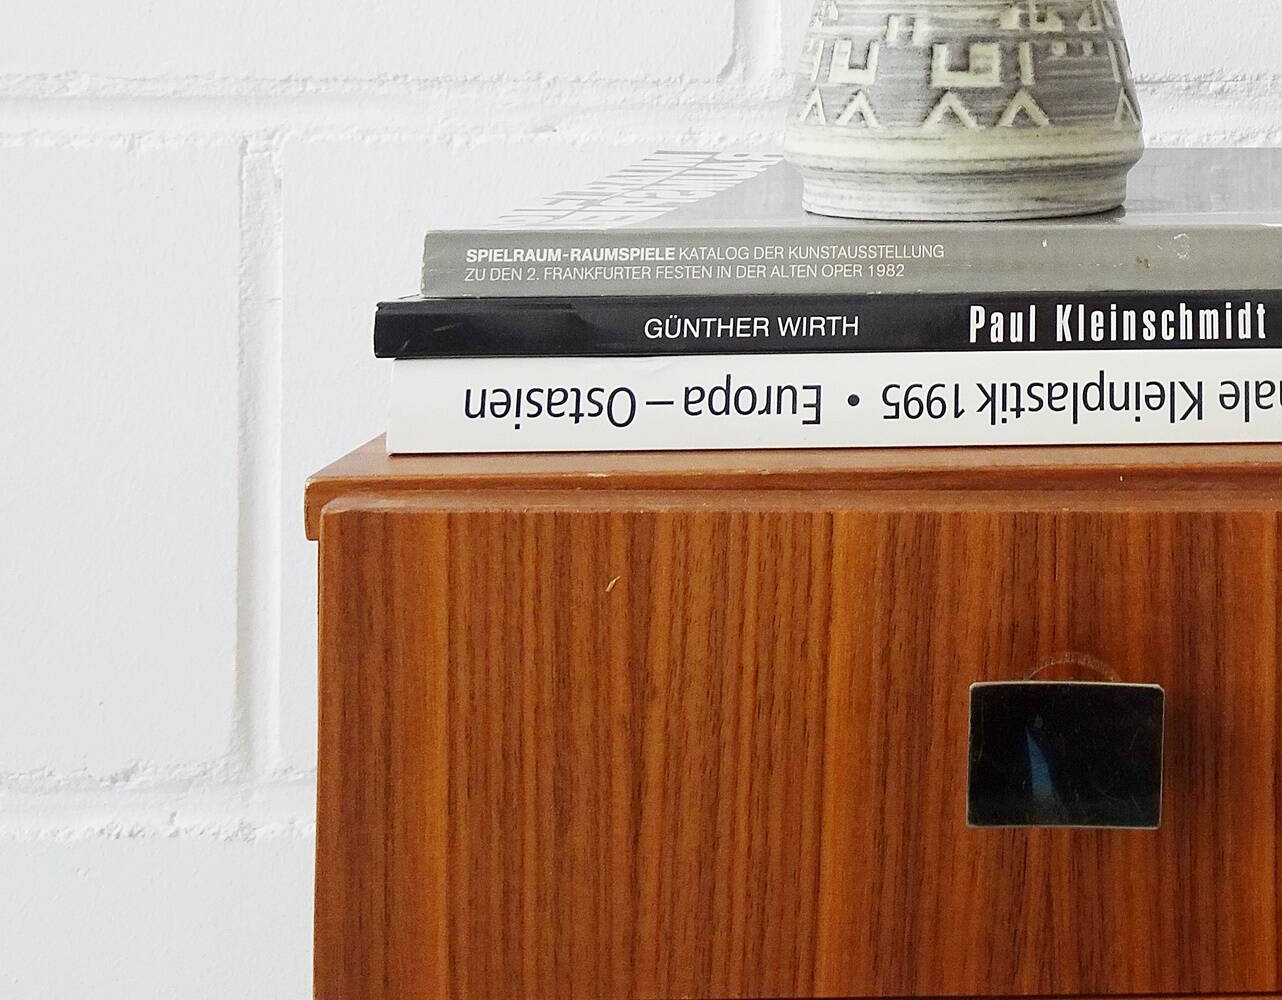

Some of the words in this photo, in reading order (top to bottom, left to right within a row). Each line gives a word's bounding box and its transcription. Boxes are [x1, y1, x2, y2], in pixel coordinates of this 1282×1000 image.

[464, 267, 486, 282] ZU
[489, 267, 523, 281] DEN
[526, 267, 540, 281] 2.
[543, 265, 652, 281] FRANKFURTER
[655, 265, 713, 280] FESTEN
[716, 265, 732, 279] IN
[735, 264, 767, 279] DER
[770, 264, 818, 278] ALTEN
[821, 263, 863, 278] OPER
[868, 263, 905, 278] 1982
[465, 247, 676, 263] SPIELRAUM-RAUMSPIELE
[679, 246, 750, 261] KATALOG
[753, 245, 784, 260] DER
[788, 244, 945, 260] KUNSTAUSSTELLUNG
[644, 314, 770, 339] GÜNTHER
[777, 314, 859, 338] WIRTH
[969, 304, 1036, 343] Paul
[1056, 301, 1267, 342] Kleinschmidt
[464, 386, 637, 430] Ostasien
[683, 373, 822, 426] Europa
[881, 384, 966, 420] 1995
[975, 370, 1203, 426] Kleinplastik
